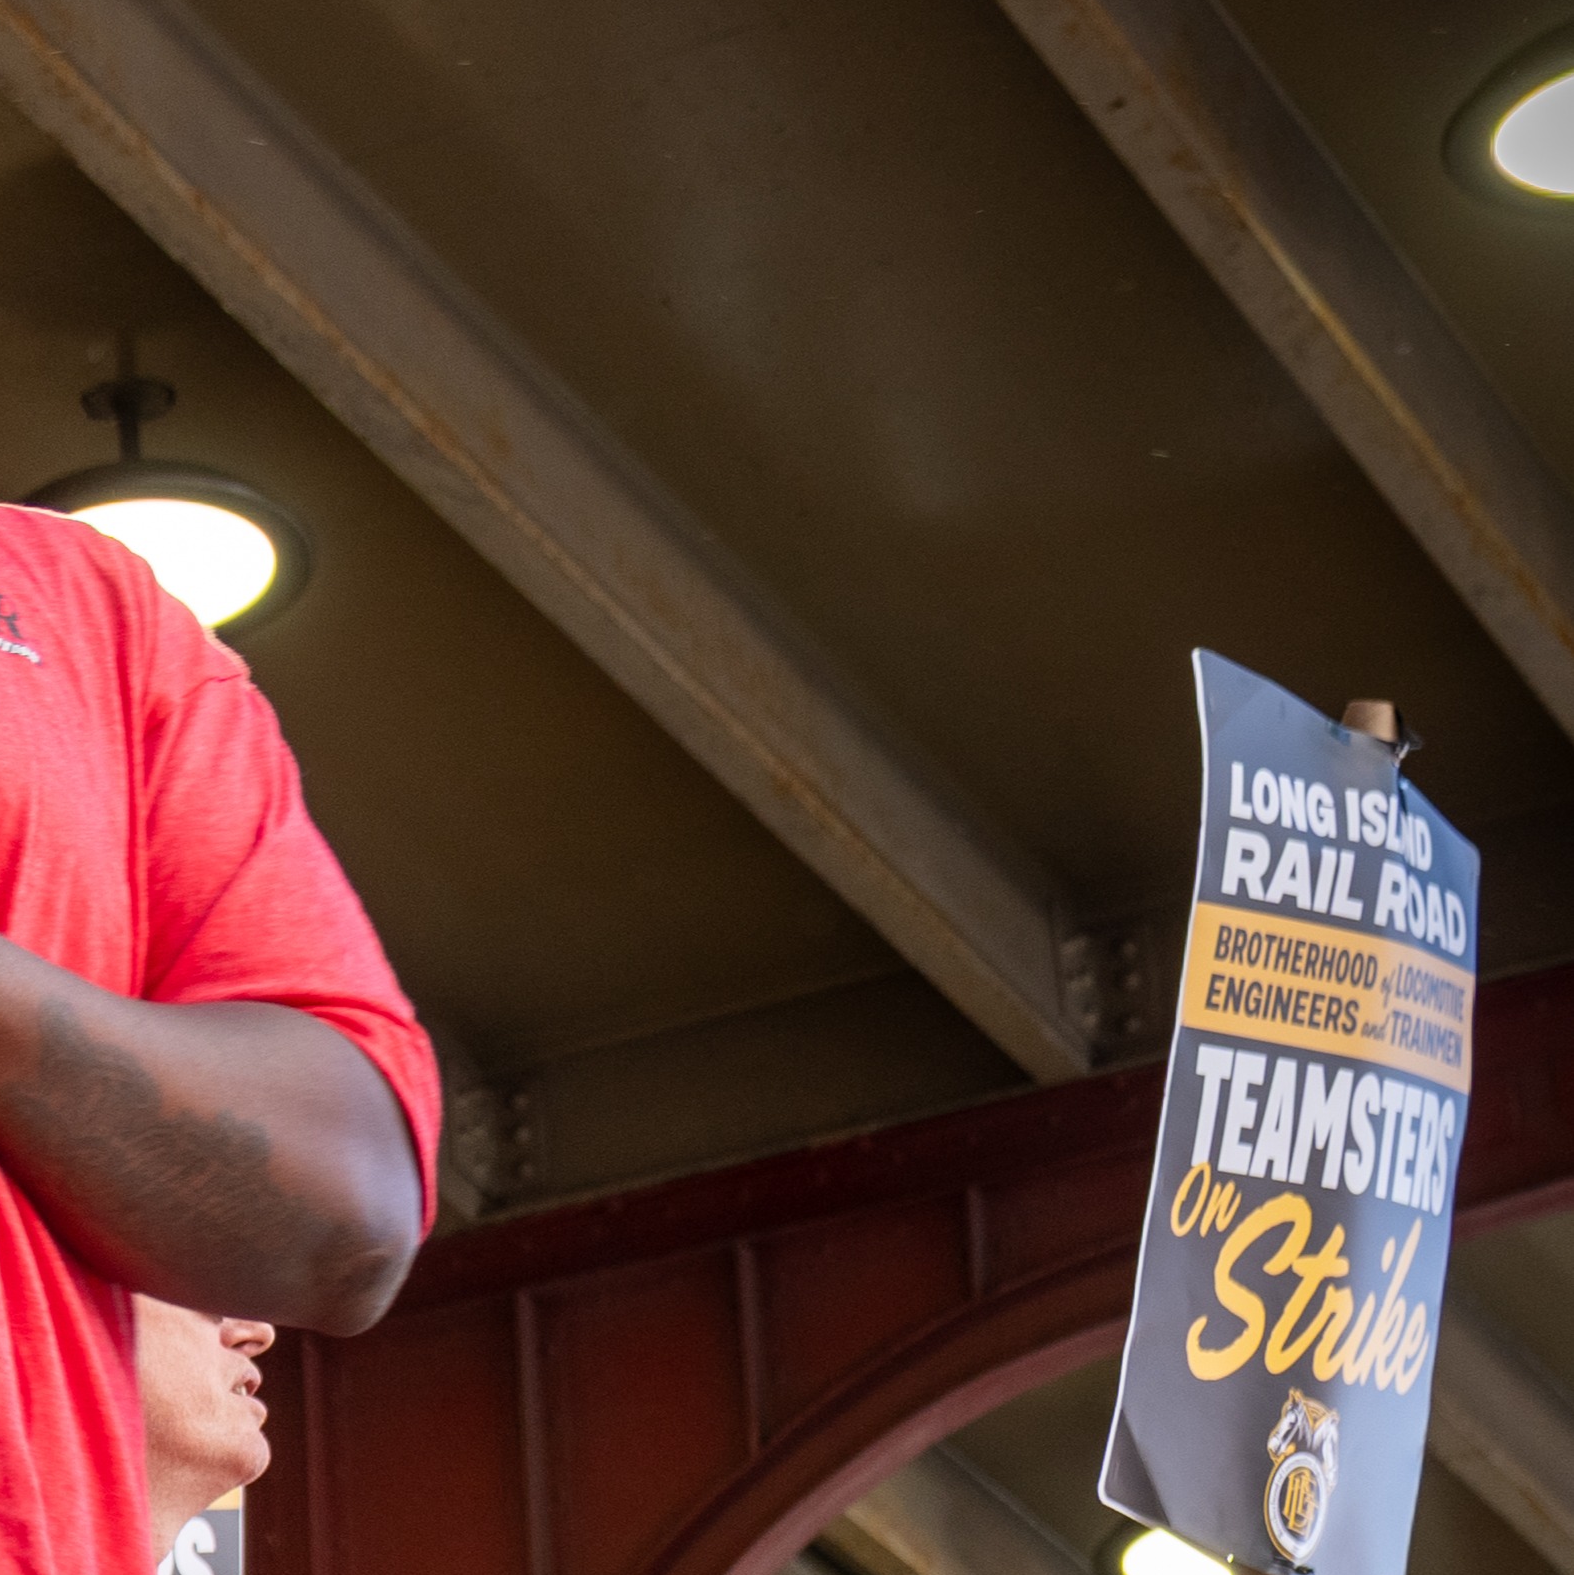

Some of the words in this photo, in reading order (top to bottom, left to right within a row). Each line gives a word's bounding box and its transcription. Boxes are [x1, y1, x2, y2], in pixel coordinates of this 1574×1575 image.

[1230, 761, 1337, 839] LONG
[1221, 827, 1363, 921] RAIL
[1374, 858, 1466, 957] ROAD
[1205, 974, 1360, 1036] ENGINEERS
[1391, 1010, 1463, 1069] TRAINMEN
[1214, 923, 1378, 990] BROTHERHOOD
[1395, 963, 1465, 1023] LOCOMOTIVE
[1192, 1044, 1456, 1216] TEAMSTERS
[1171, 1161, 1242, 1237] On
[1186, 1192, 1429, 1395] Strike
